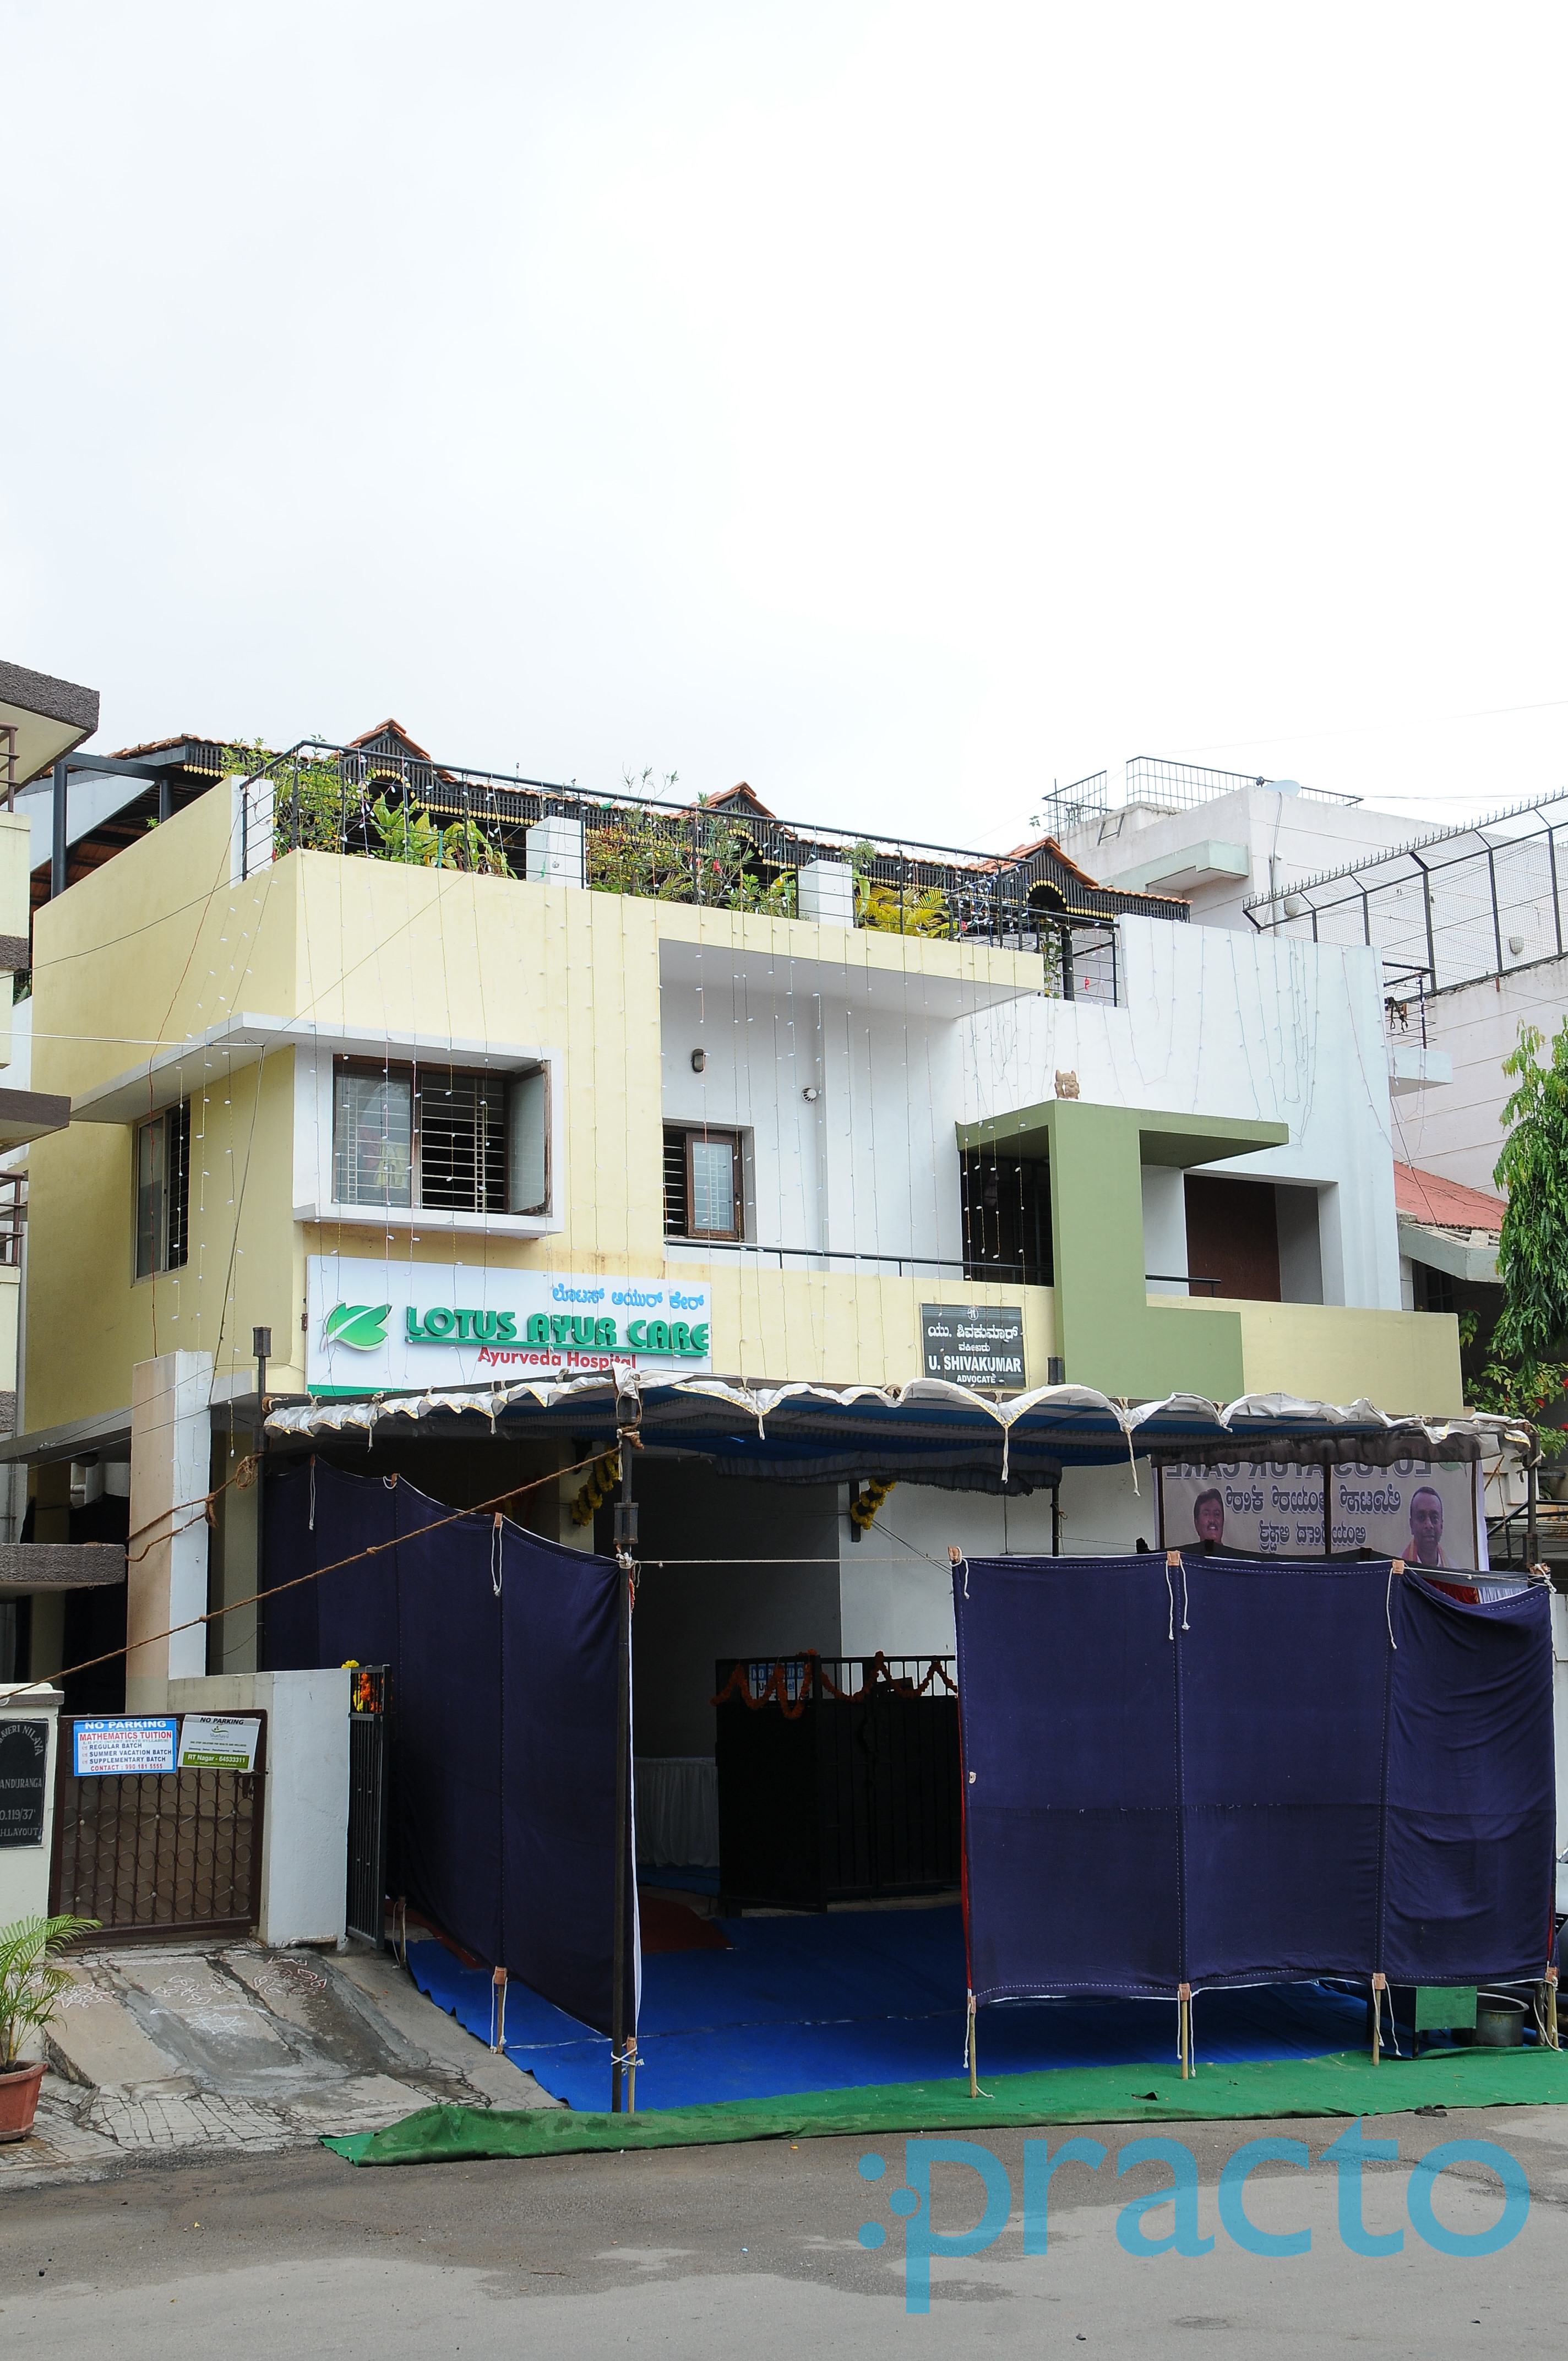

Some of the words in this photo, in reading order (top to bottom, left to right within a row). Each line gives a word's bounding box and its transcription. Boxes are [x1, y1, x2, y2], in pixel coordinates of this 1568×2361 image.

[669, 1291, 704, 1310] ಕೇರ್
[406, 1305, 517, 1339] LOTUS
[527, 1313, 617, 1345] AYUR
[627, 1319, 709, 1350] CARE
[478, 1347, 561, 1367] Ayurveda
[928, 1355, 941, 1370] U.
[944, 1355, 1021, 1373] SHIVAKUMAR
[956, 1374, 996, 1384] ADVOCATE
[22, 1725, 43, 1756] NILAYA
[80, 1732, 138, 1741] MATHEMATICS
